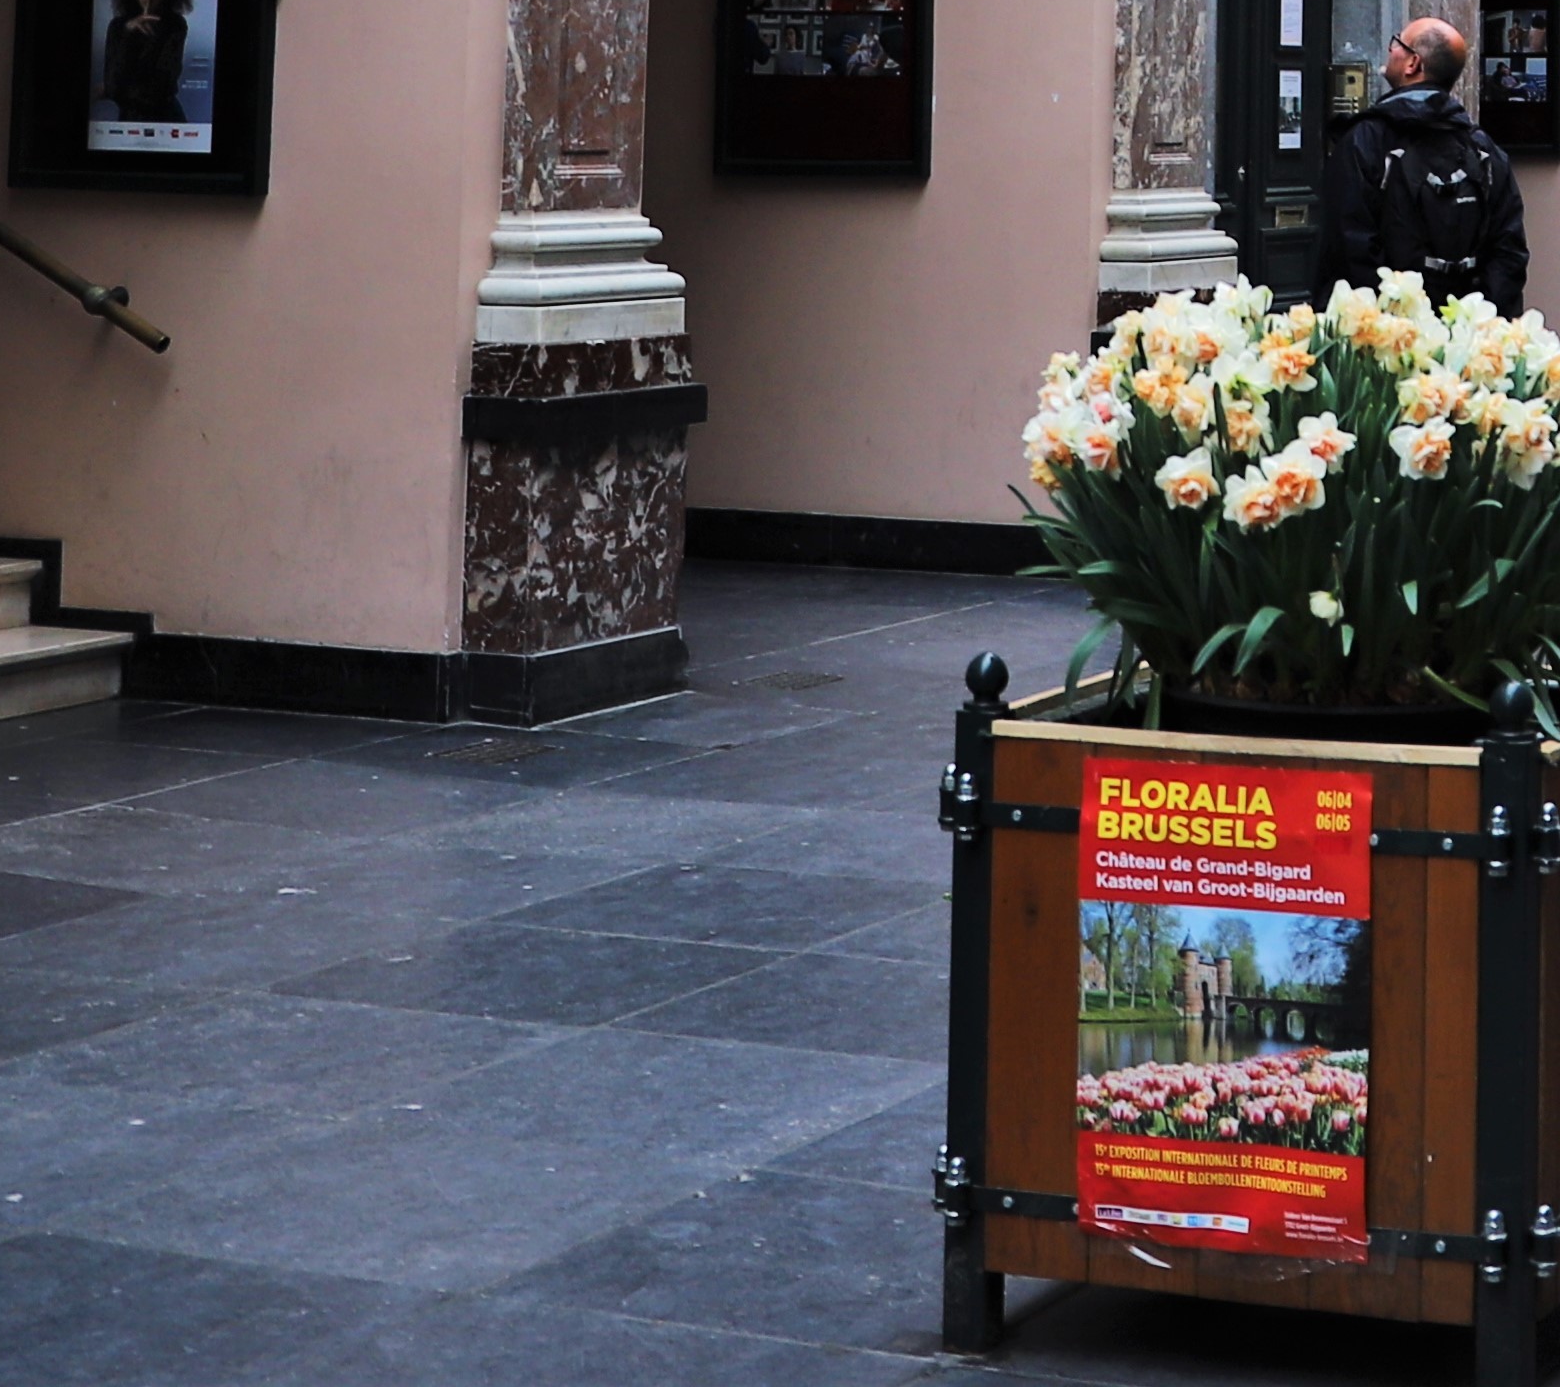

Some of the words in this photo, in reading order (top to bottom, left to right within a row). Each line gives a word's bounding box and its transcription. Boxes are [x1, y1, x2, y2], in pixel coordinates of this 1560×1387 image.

[1100, 777, 1274, 816] FLORALIA
[1097, 810, 1277, 850] BRUSSELS
[1096, 851, 1166, 870] Château
[1170, 855, 1192, 872] de
[1197, 858, 1311, 881] Grand-Bigard
[1096, 873, 1158, 891] Kasteel
[1163, 879, 1193, 893] van
[1197, 879, 1345, 905] Groot-Bijgaarden
[1109, 1145, 1161, 1162] EXPOSITION
[1162, 1150, 1238, 1168] INTERNATIONALE
[1241, 1155, 1253, 1169] DE
[1255, 1157, 1286, 1173] FLEURS
[1287, 1161, 1299, 1174] DE
[1299, 1162, 1348, 1181] PRINTEMPS
[1112, 1164, 1185, 1184] INTERNATIONALE
[1187, 1171, 1326, 1198] BLOEMBOLLENTENTOONSTELLING
